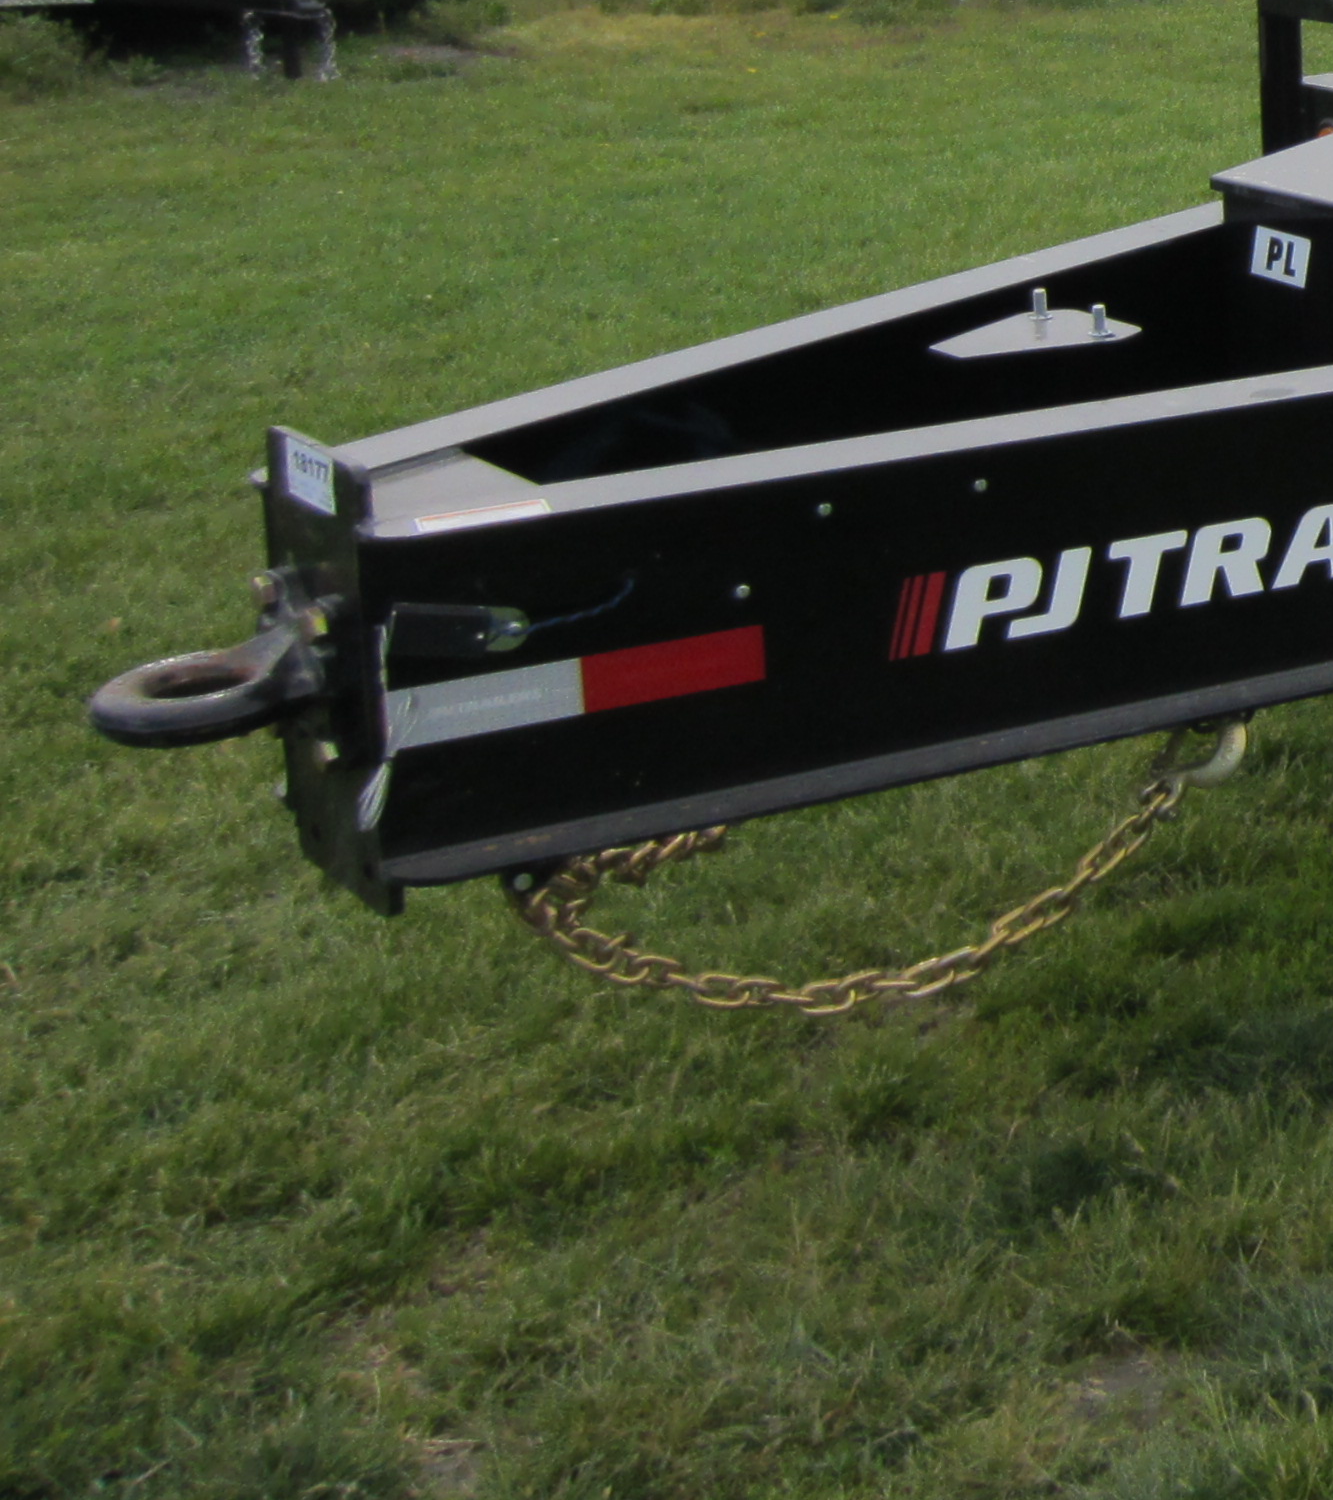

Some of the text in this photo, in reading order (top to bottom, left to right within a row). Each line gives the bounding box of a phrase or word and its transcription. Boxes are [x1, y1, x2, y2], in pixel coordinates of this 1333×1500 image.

[1265, 235, 1296, 277] PL
[293, 449, 329, 484] 18177
[943, 546, 1092, 652] PJ
